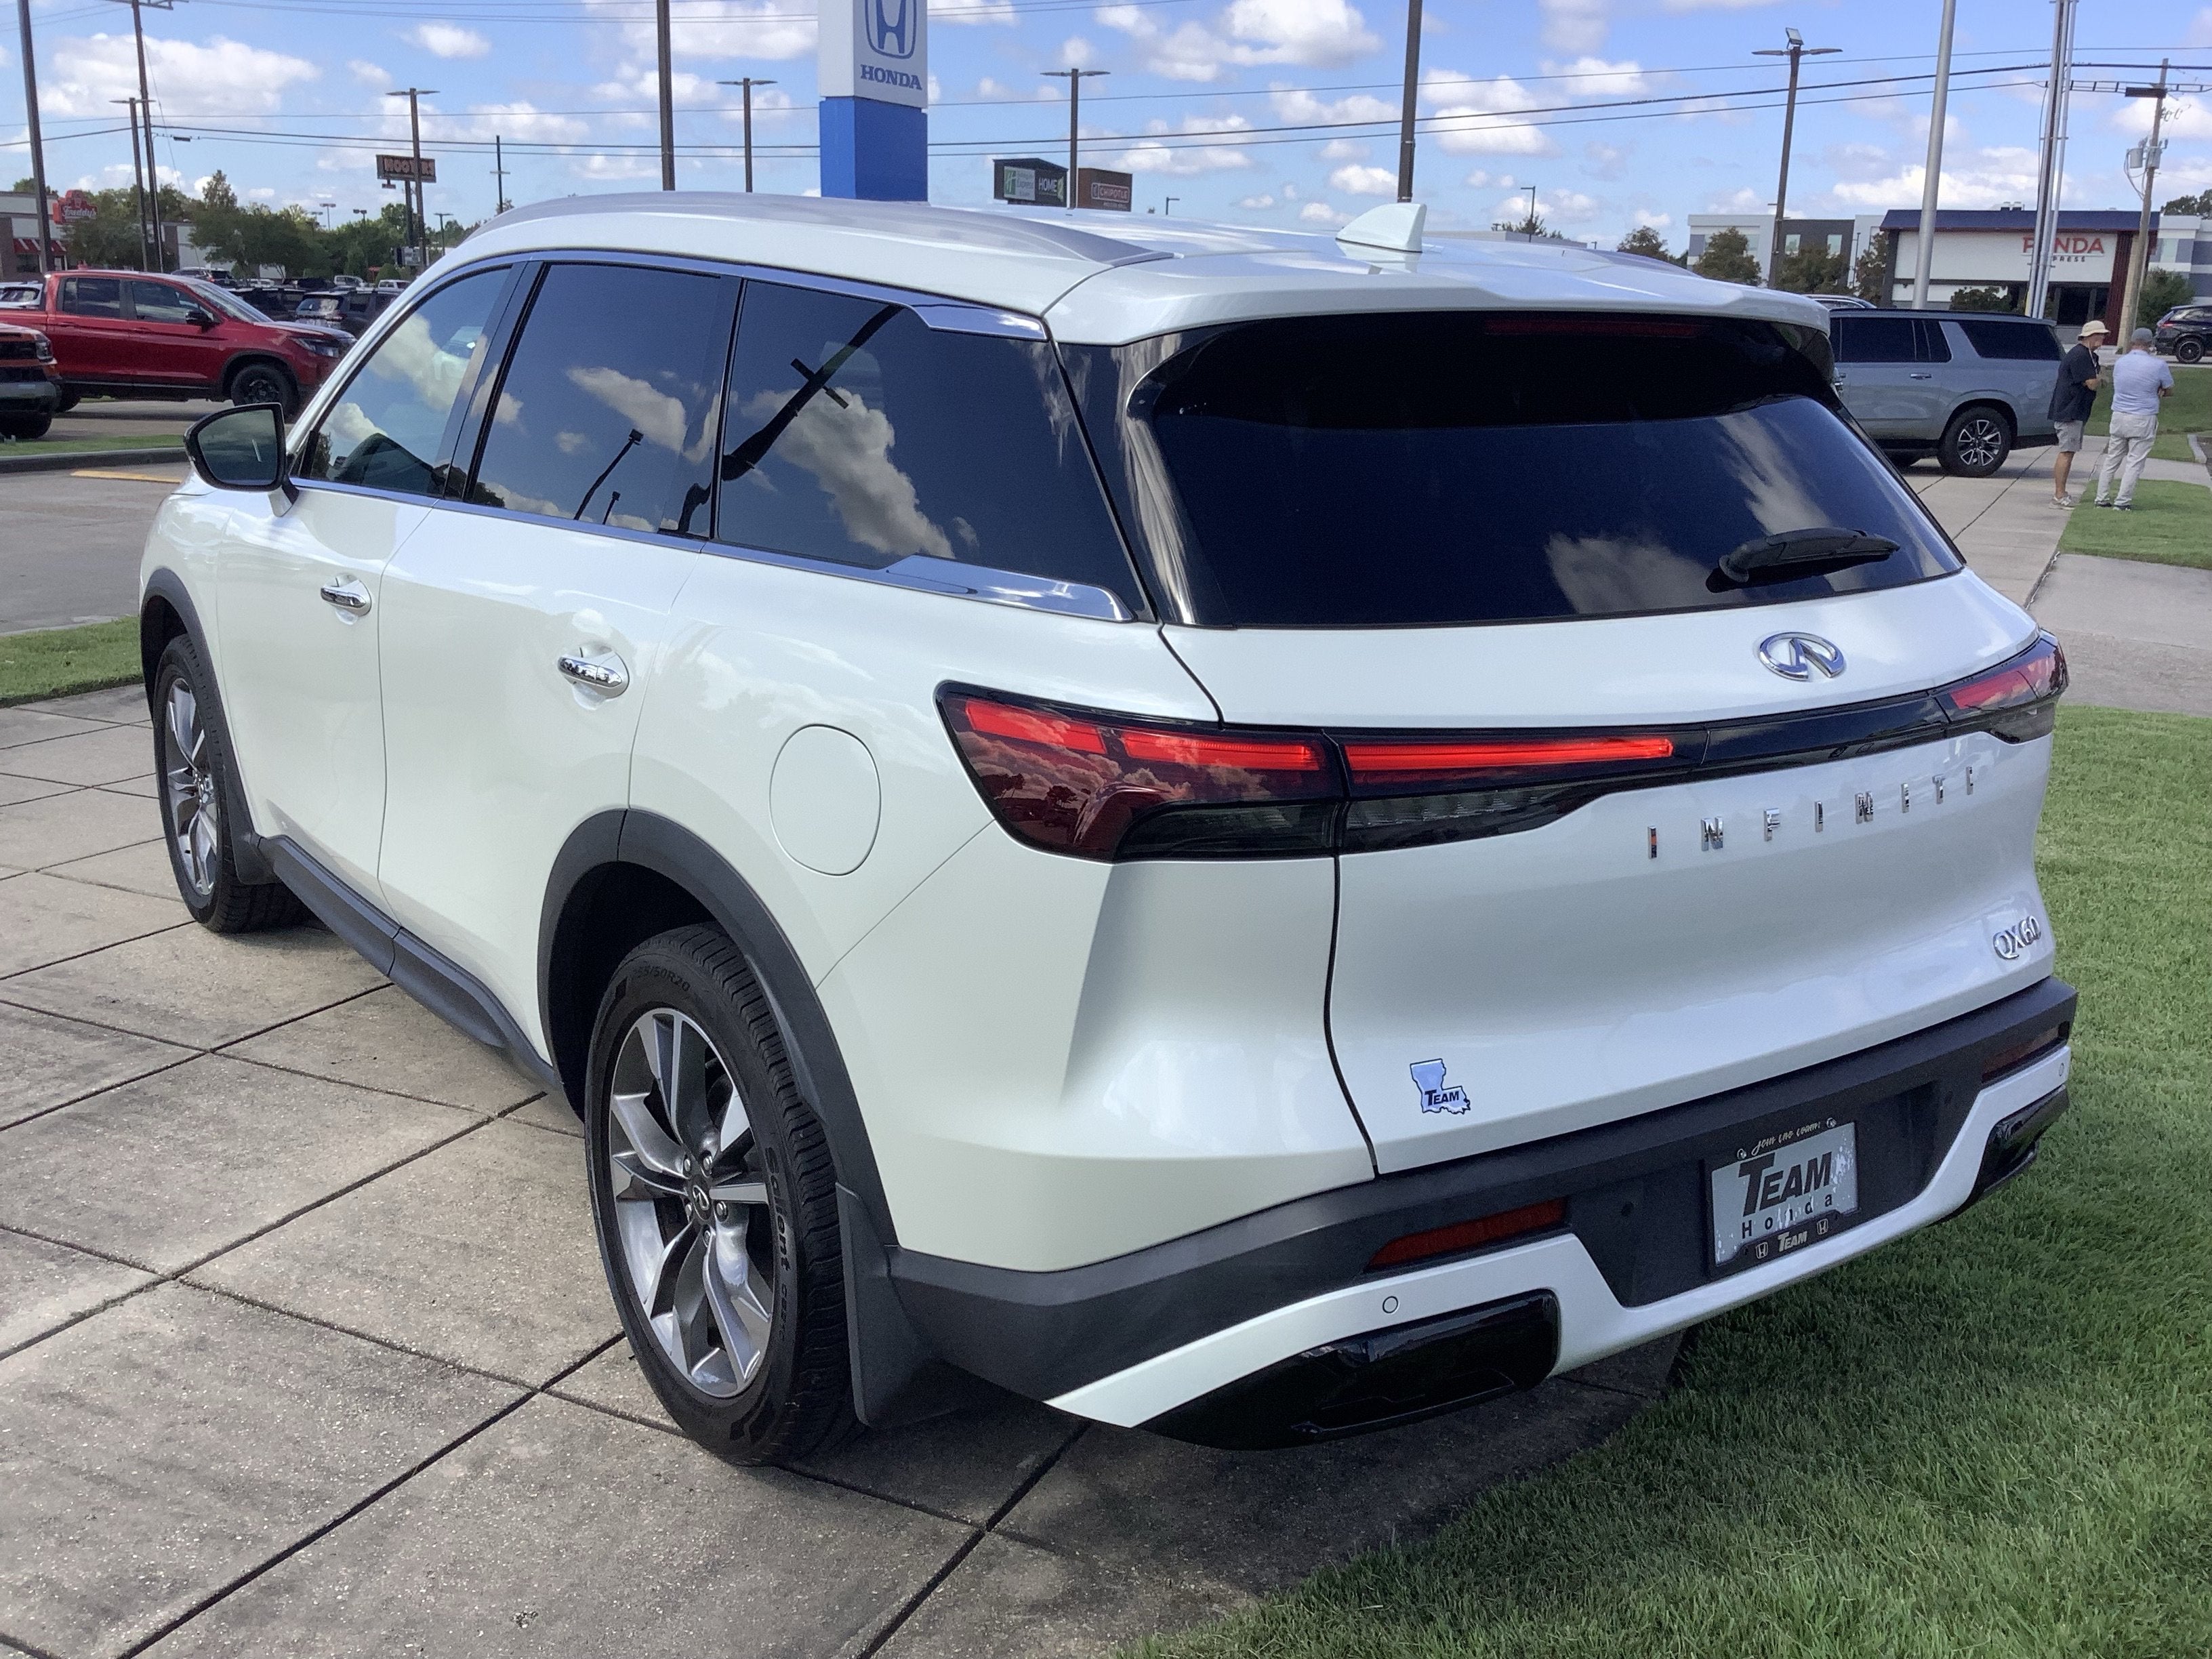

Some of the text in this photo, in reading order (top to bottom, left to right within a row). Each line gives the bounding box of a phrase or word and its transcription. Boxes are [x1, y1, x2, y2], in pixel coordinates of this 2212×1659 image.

[860, 64, 922, 90] HONDA
[384, 157, 434, 176] HOOTRS
[1099, 186, 1128, 199] CHIPOTLE
[2022, 235, 2104, 253] PNDA
[1647, 766, 1974, 859] INFINITI
[1993, 915, 2041, 960] QX60
[1425, 1089, 1459, 1106] TEAM
[1738, 1152, 1832, 1217] TEAM
[1778, 1231, 1807, 1252] TEAM
